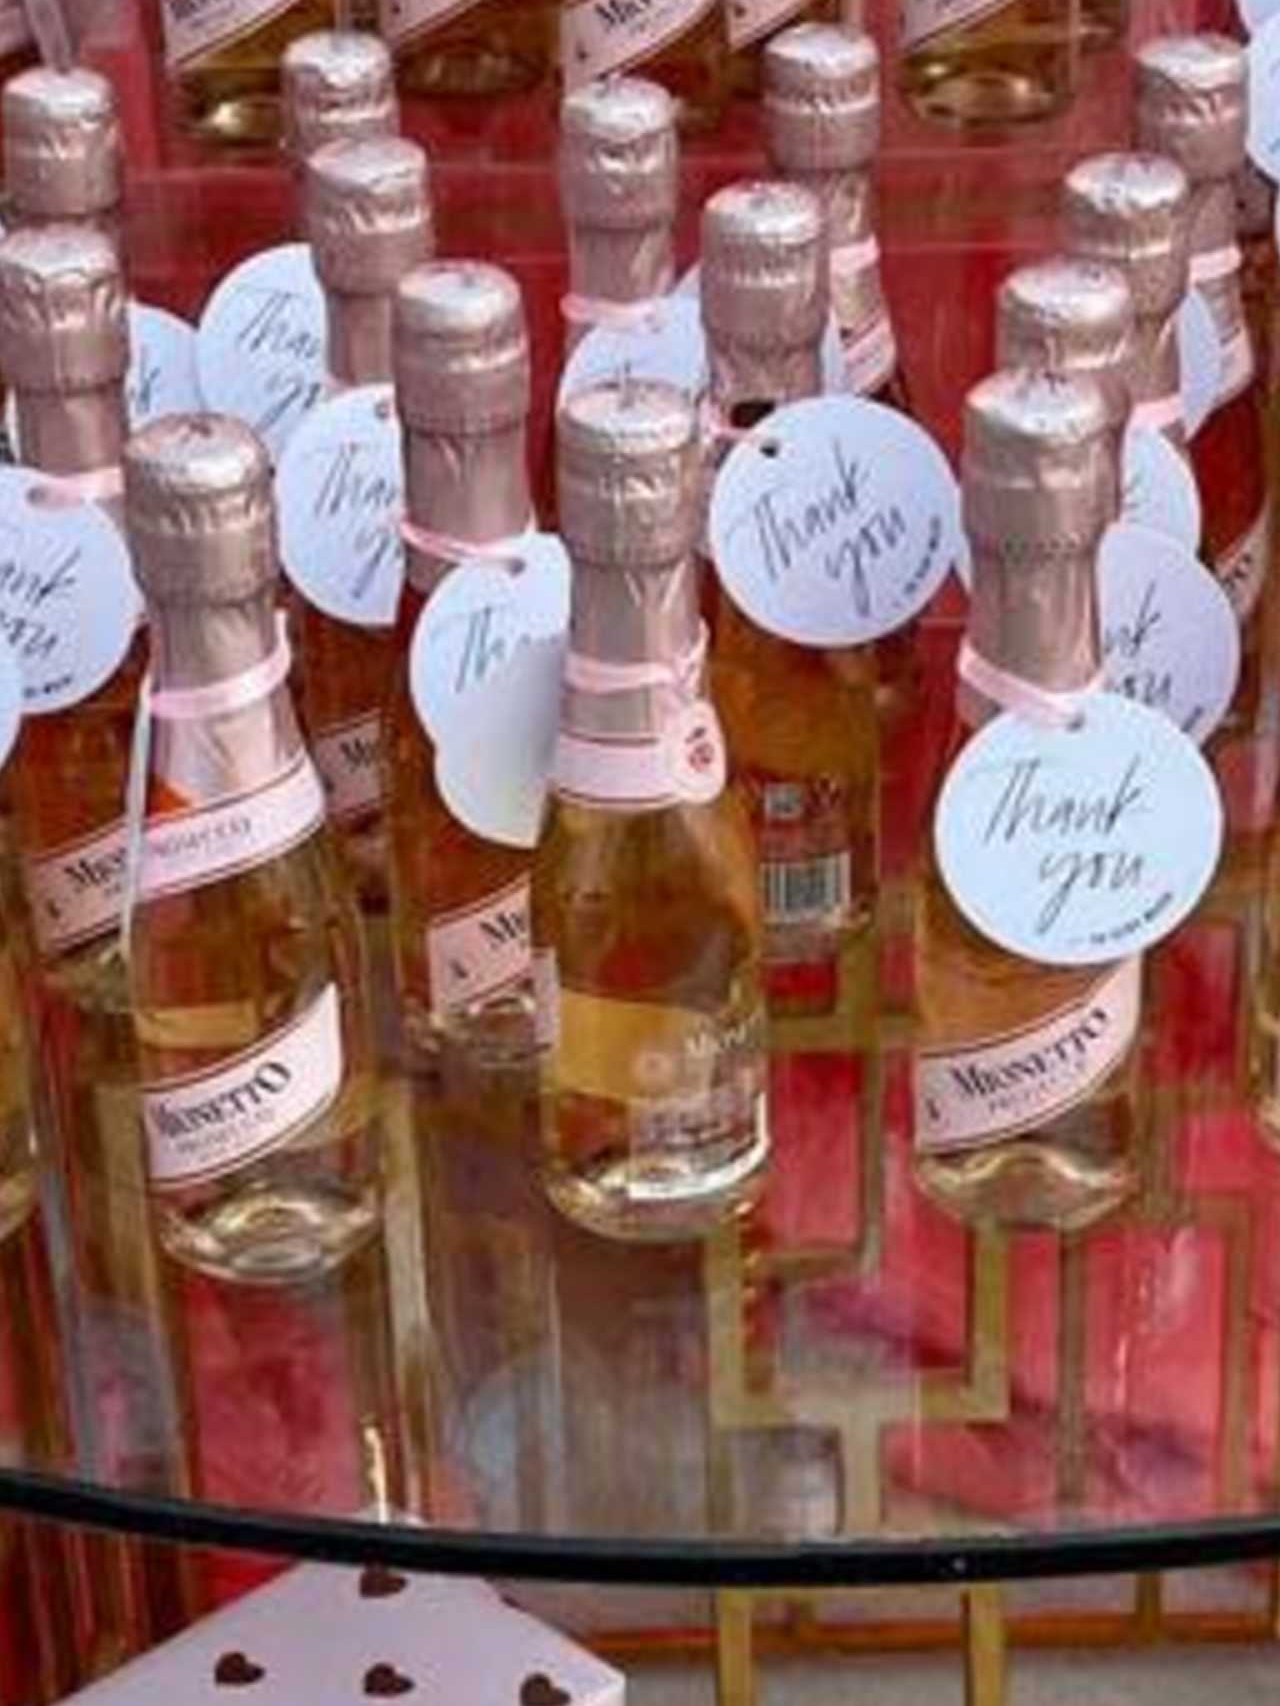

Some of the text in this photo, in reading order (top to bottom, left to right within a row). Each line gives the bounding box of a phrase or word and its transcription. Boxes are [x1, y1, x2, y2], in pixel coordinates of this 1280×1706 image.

[728, 437, 870, 581] Thank
[825, 506, 907, 617] you
[971, 752, 1153, 845] Thank
[1036, 847, 1143, 936] you
[950, 1005, 1111, 1097] MIONETTO
